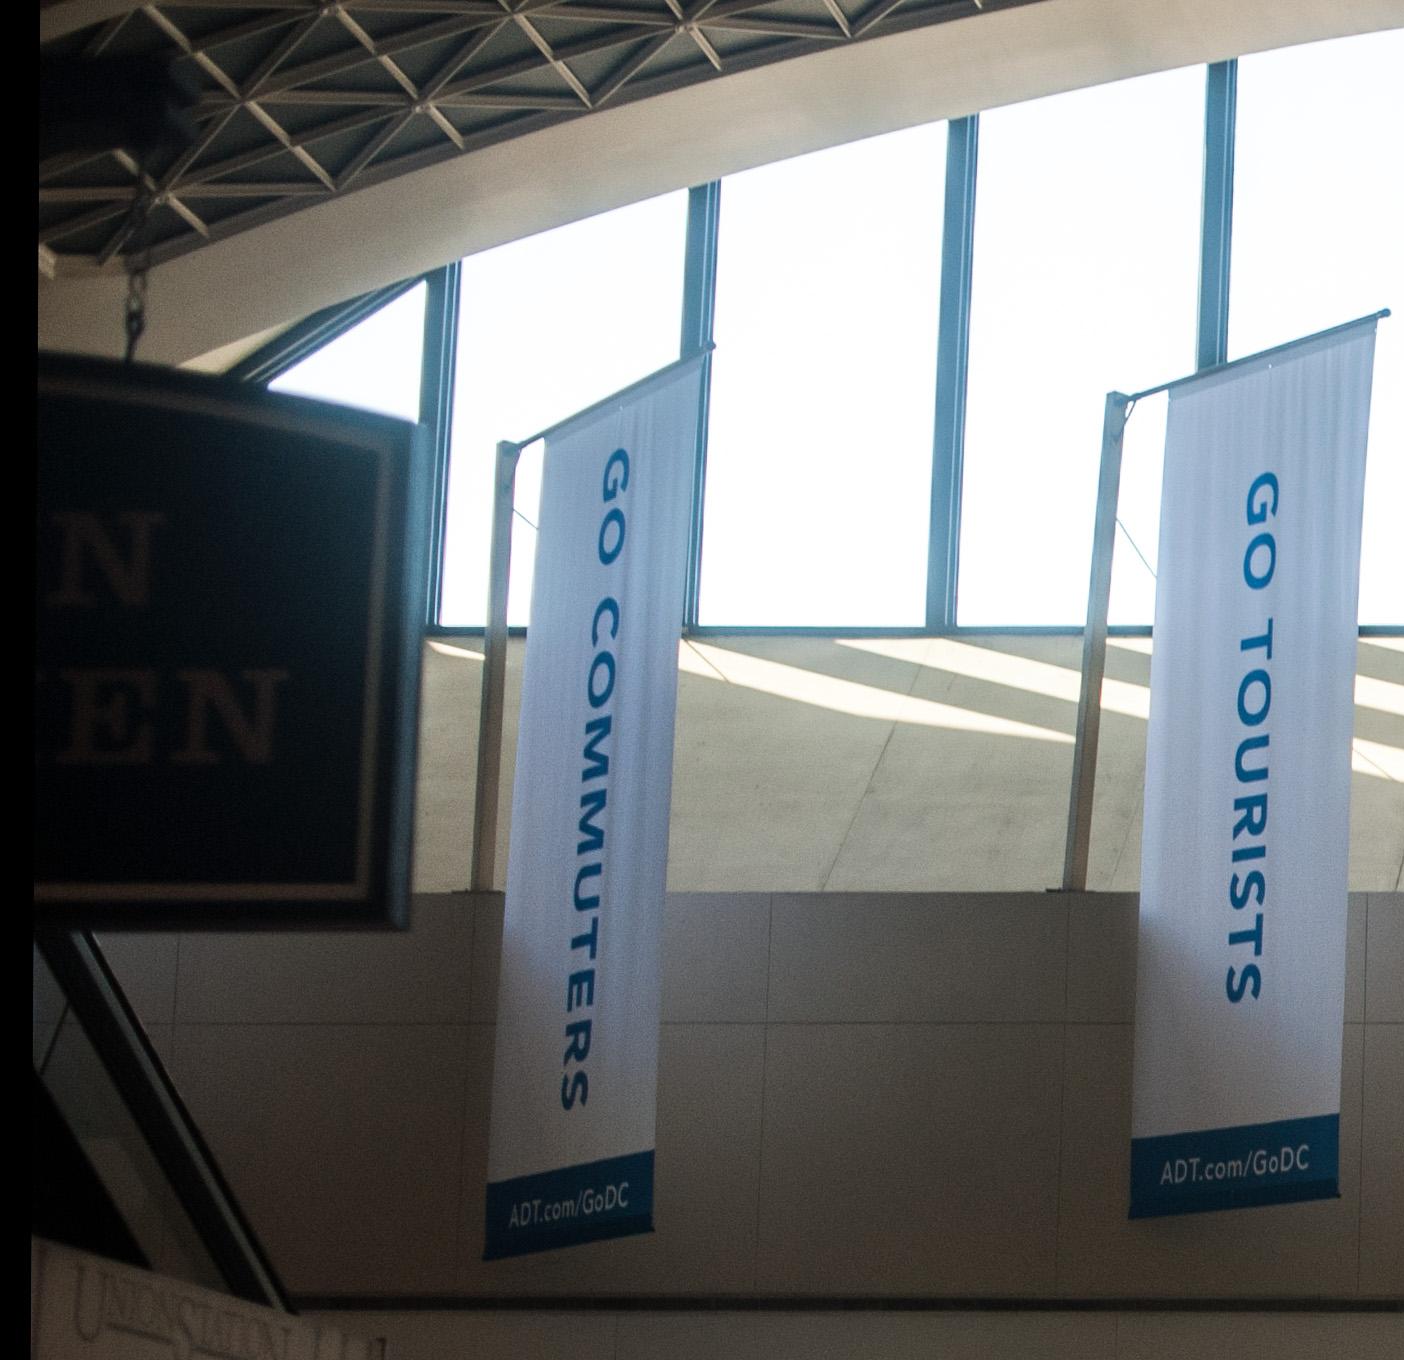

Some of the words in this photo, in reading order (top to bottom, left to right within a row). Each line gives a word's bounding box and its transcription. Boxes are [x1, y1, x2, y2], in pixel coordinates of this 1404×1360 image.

[597, 447, 630, 566] GO
[1242, 472, 1280, 591] GO
[38, 666, 291, 766] EN
[560, 595, 621, 1112] COMMUTERS
[1226, 616, 1274, 1005] TOURISTS
[509, 1182, 630, 1230] ADT.com/GoDC
[1160, 1143, 1310, 1187] ADT.com/GoDC
